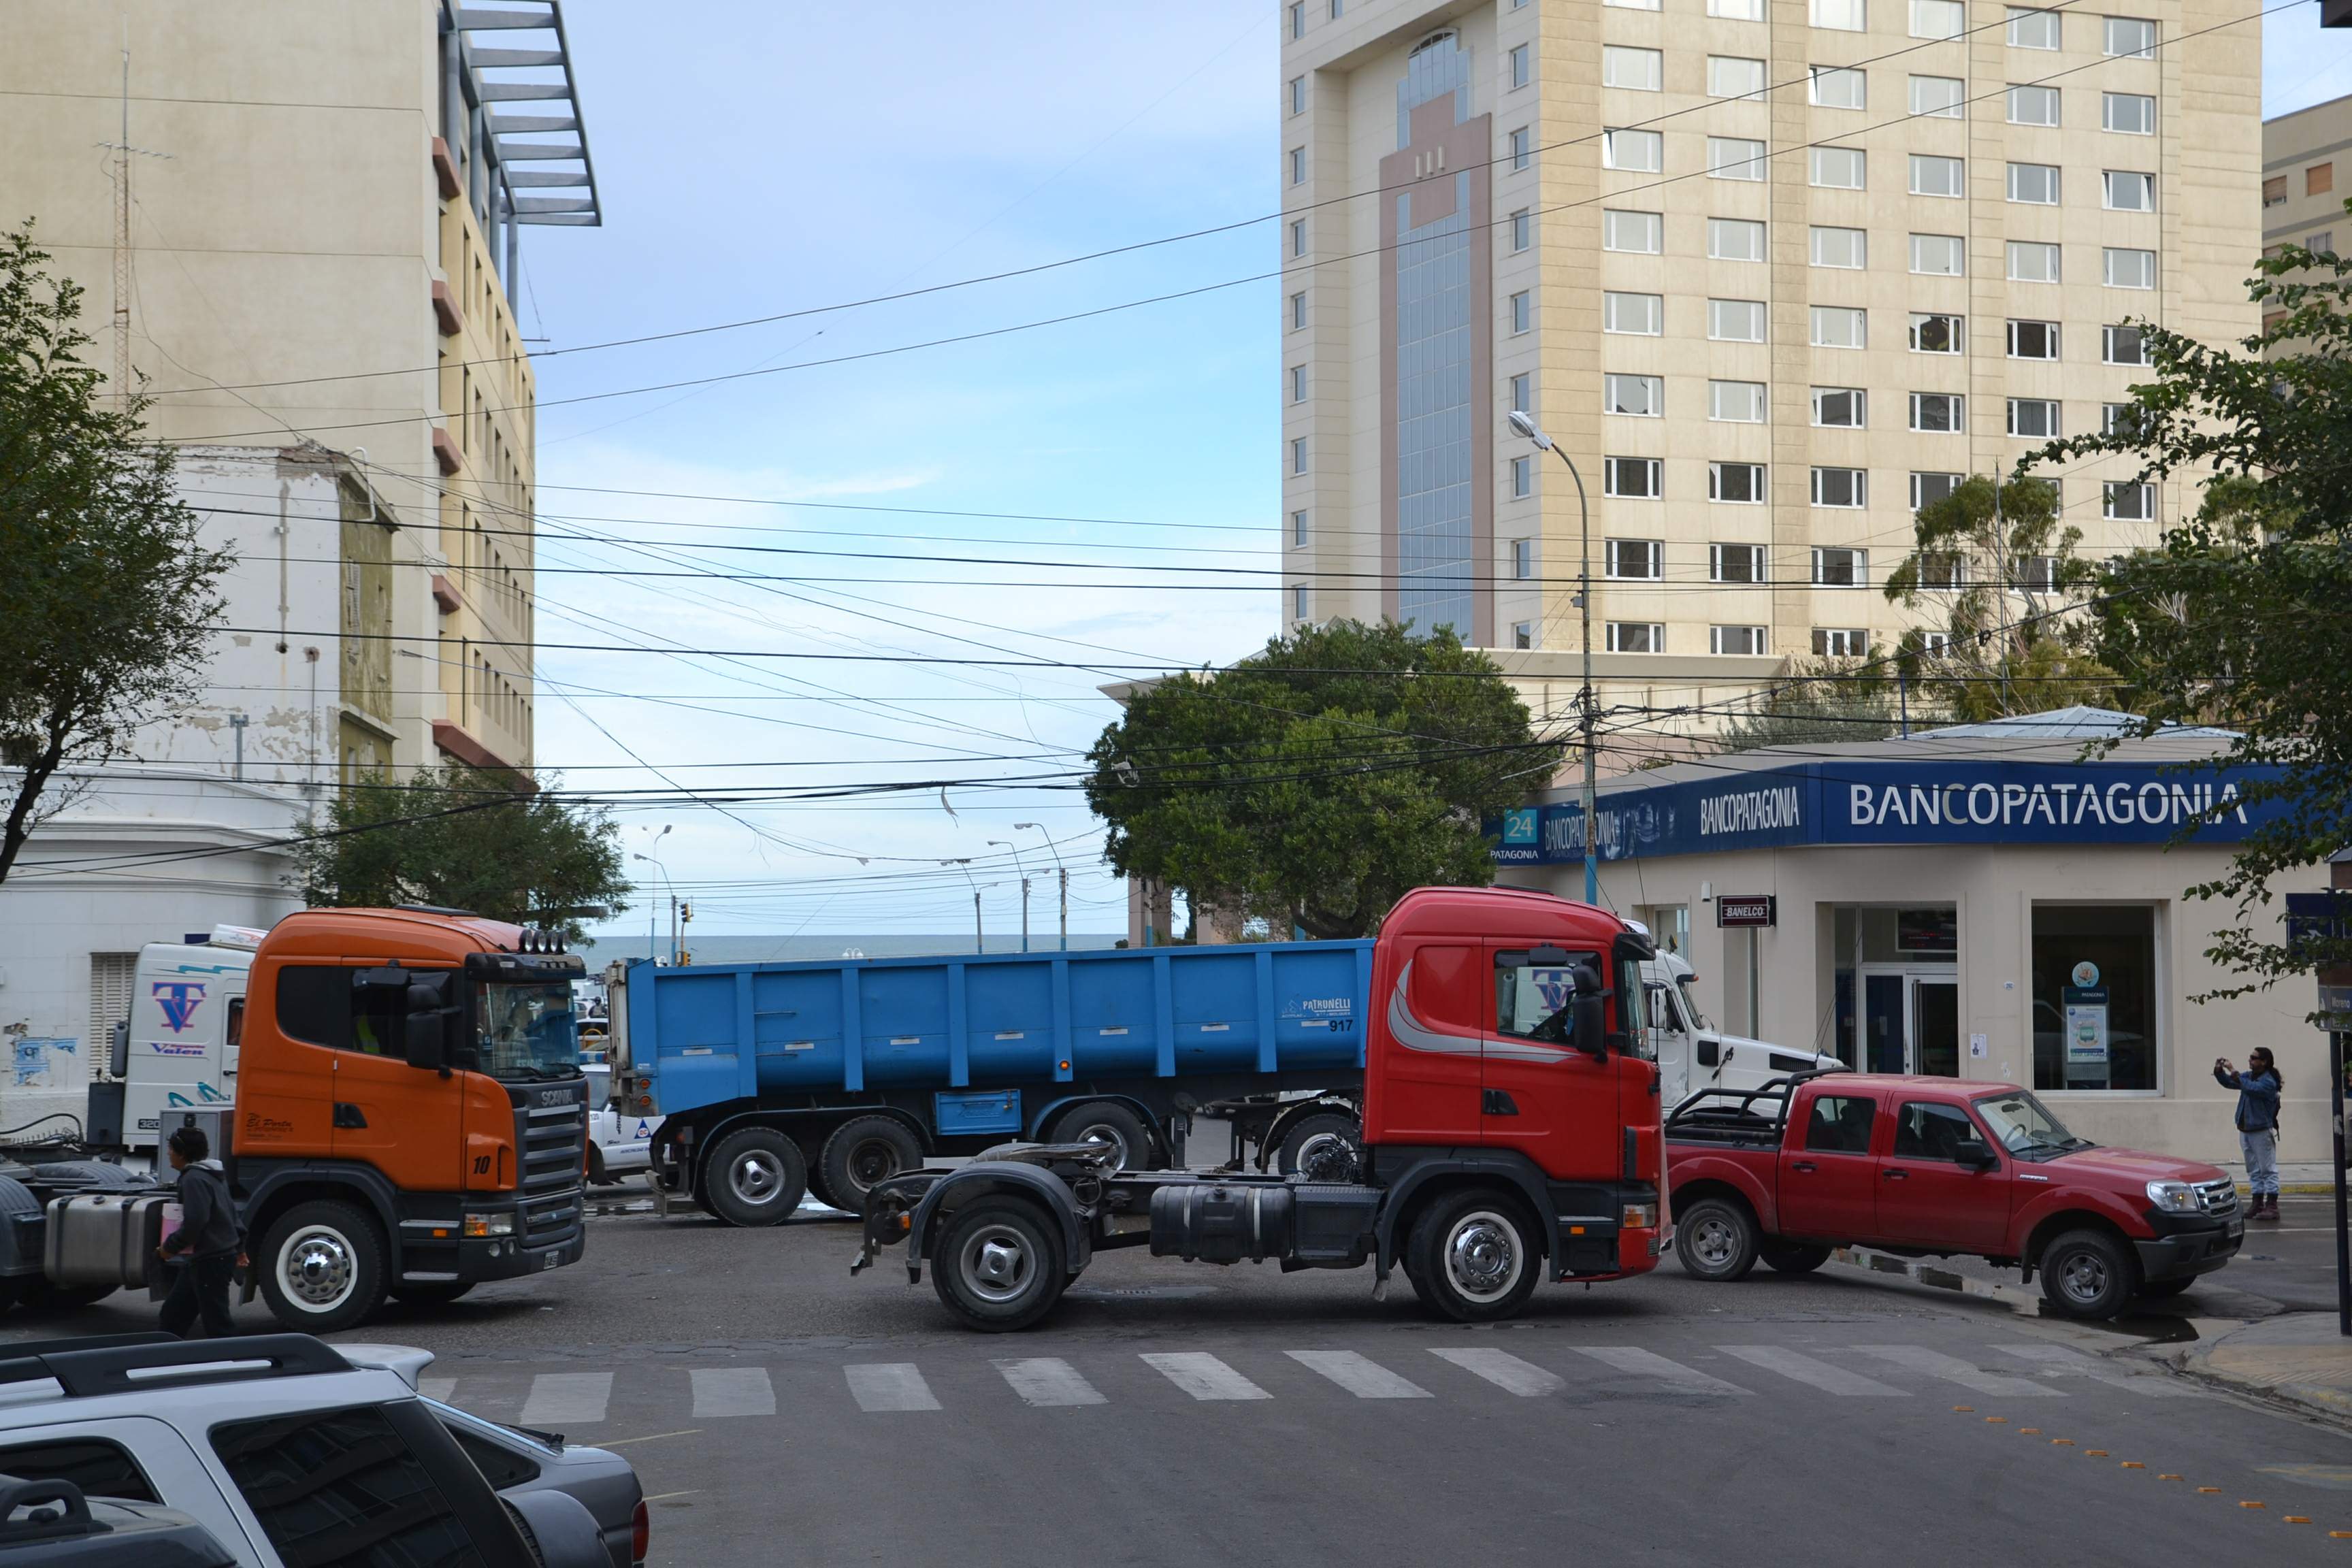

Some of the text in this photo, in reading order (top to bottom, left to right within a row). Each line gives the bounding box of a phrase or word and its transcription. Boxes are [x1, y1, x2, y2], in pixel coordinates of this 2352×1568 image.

[1701, 786, 1799, 835] BANCOPATAGONIA
[1850, 783, 2247, 825] BANCOPATAGONIA
[1508, 817, 1533, 836] 24
[1546, 811, 1616, 851] BANCOPATONIA
[1490, 850, 1538, 859] PATAGONIA
[1727, 906, 1763, 917] BANELCO
[1330, 1019, 1353, 1032] 917
[541, 1089, 573, 1106] SCANIA
[474, 1156, 491, 1175] 10
